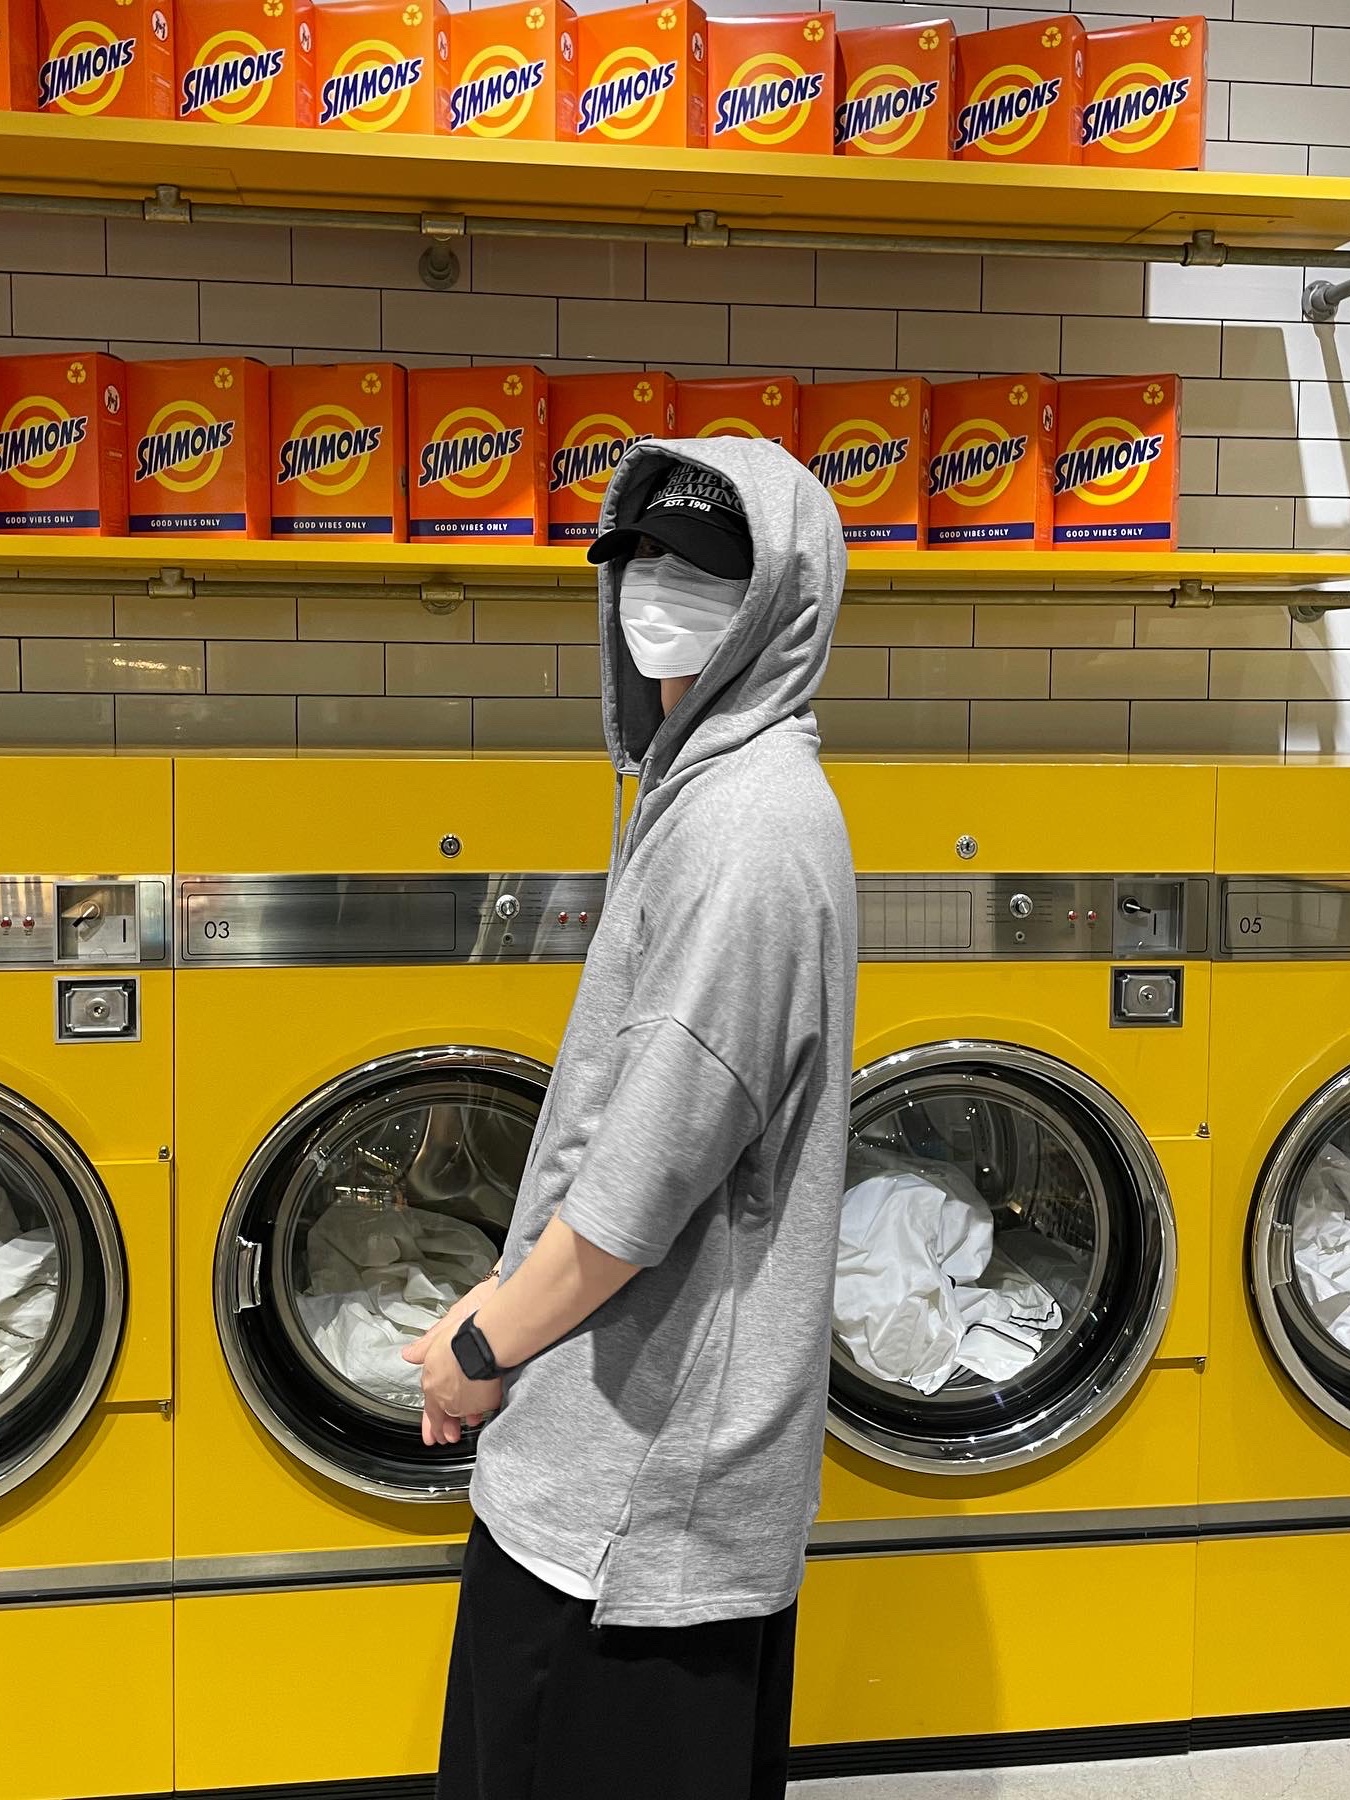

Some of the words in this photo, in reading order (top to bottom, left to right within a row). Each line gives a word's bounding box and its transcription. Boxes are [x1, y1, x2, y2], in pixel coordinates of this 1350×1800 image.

[38, 38, 136, 108] SIMMONS
[180, 48, 286, 116] SIMMONS
[319, 57, 423, 125] SIMMONS
[450, 59, 547, 131] SIMMONS
[577, 60, 677, 135] SIMMONS
[714, 73, 825, 135] SIMMONS
[834, 80, 941, 147] SIMMONS
[953, 78, 1062, 151] SIMMONS
[1081, 77, 1191, 146] SIMMONS
[134, 421, 235, 483] SIMMONS
[276, 425, 383, 485] SIMMONS
[417, 427, 524, 488] SIMMONS
[549, 433, 655, 493] SIMMO
[929, 435, 1028, 497] SIMMONS
[1053, 434, 1164, 496] SIMMONS
[5, 516, 27, 524] GOOD
[29, 516, 52, 524] VIBES
[54, 515, 75, 523] ONLY
[151, 518, 173, 527] GOOD
[175, 518, 198, 527] VIBES
[200, 518, 221, 527] ONLY
[293, 520, 316, 529] GOOD
[318, 520, 342, 529] VIBES
[344, 520, 367, 529] ONLY
[434, 523, 458, 532] GOOD
[460, 523, 484, 532] VIBES
[486, 523, 509, 532] ONLY
[663, 499, 685, 508] EST.
[688, 500, 712, 513] 1901
[844, 529, 868, 538] VIBES
[870, 529, 892, 538] ONLY
[939, 530, 961, 539] GOOD
[963, 529, 986, 538] VIBES
[988, 528, 1010, 537] ONLY
[1066, 529, 1089, 538] GOOD
[1091, 528, 1117, 537] VIBES
[1120, 527, 1144, 537] ONLY
[204, 920, 230, 940] 03
[1239, 915, 1263, 935] 05
